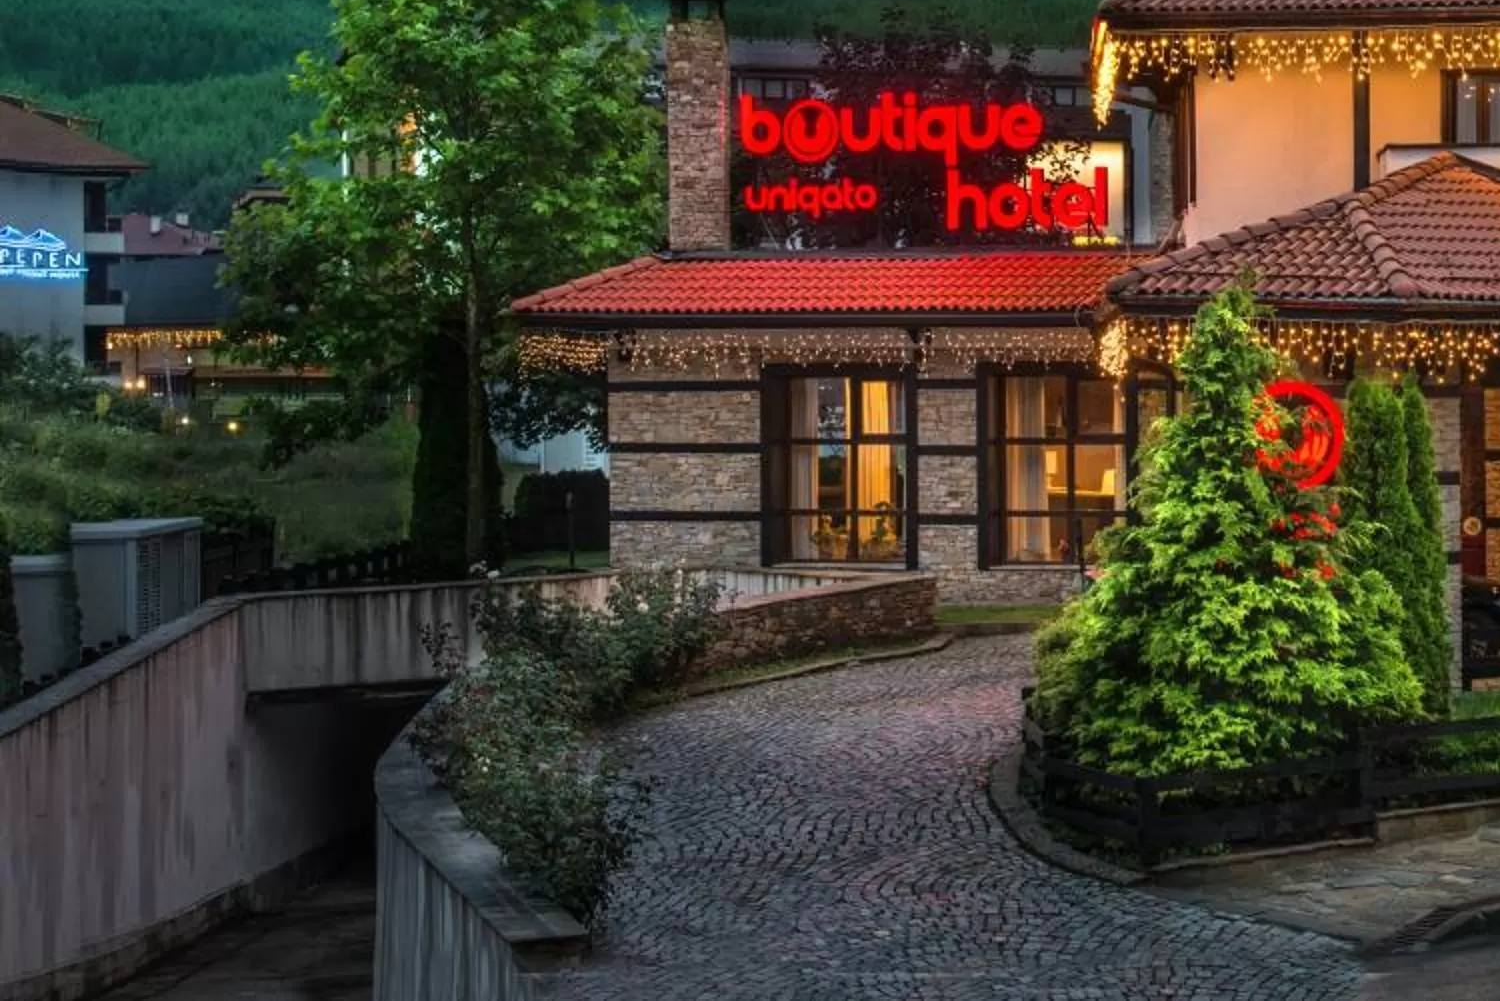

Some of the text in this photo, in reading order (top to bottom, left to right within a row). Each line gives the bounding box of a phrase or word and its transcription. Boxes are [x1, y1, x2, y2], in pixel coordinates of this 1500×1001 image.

[738, 91, 1045, 167] boutique
[743, 177, 879, 217] uniqato
[945, 166, 1109, 231] hotel
